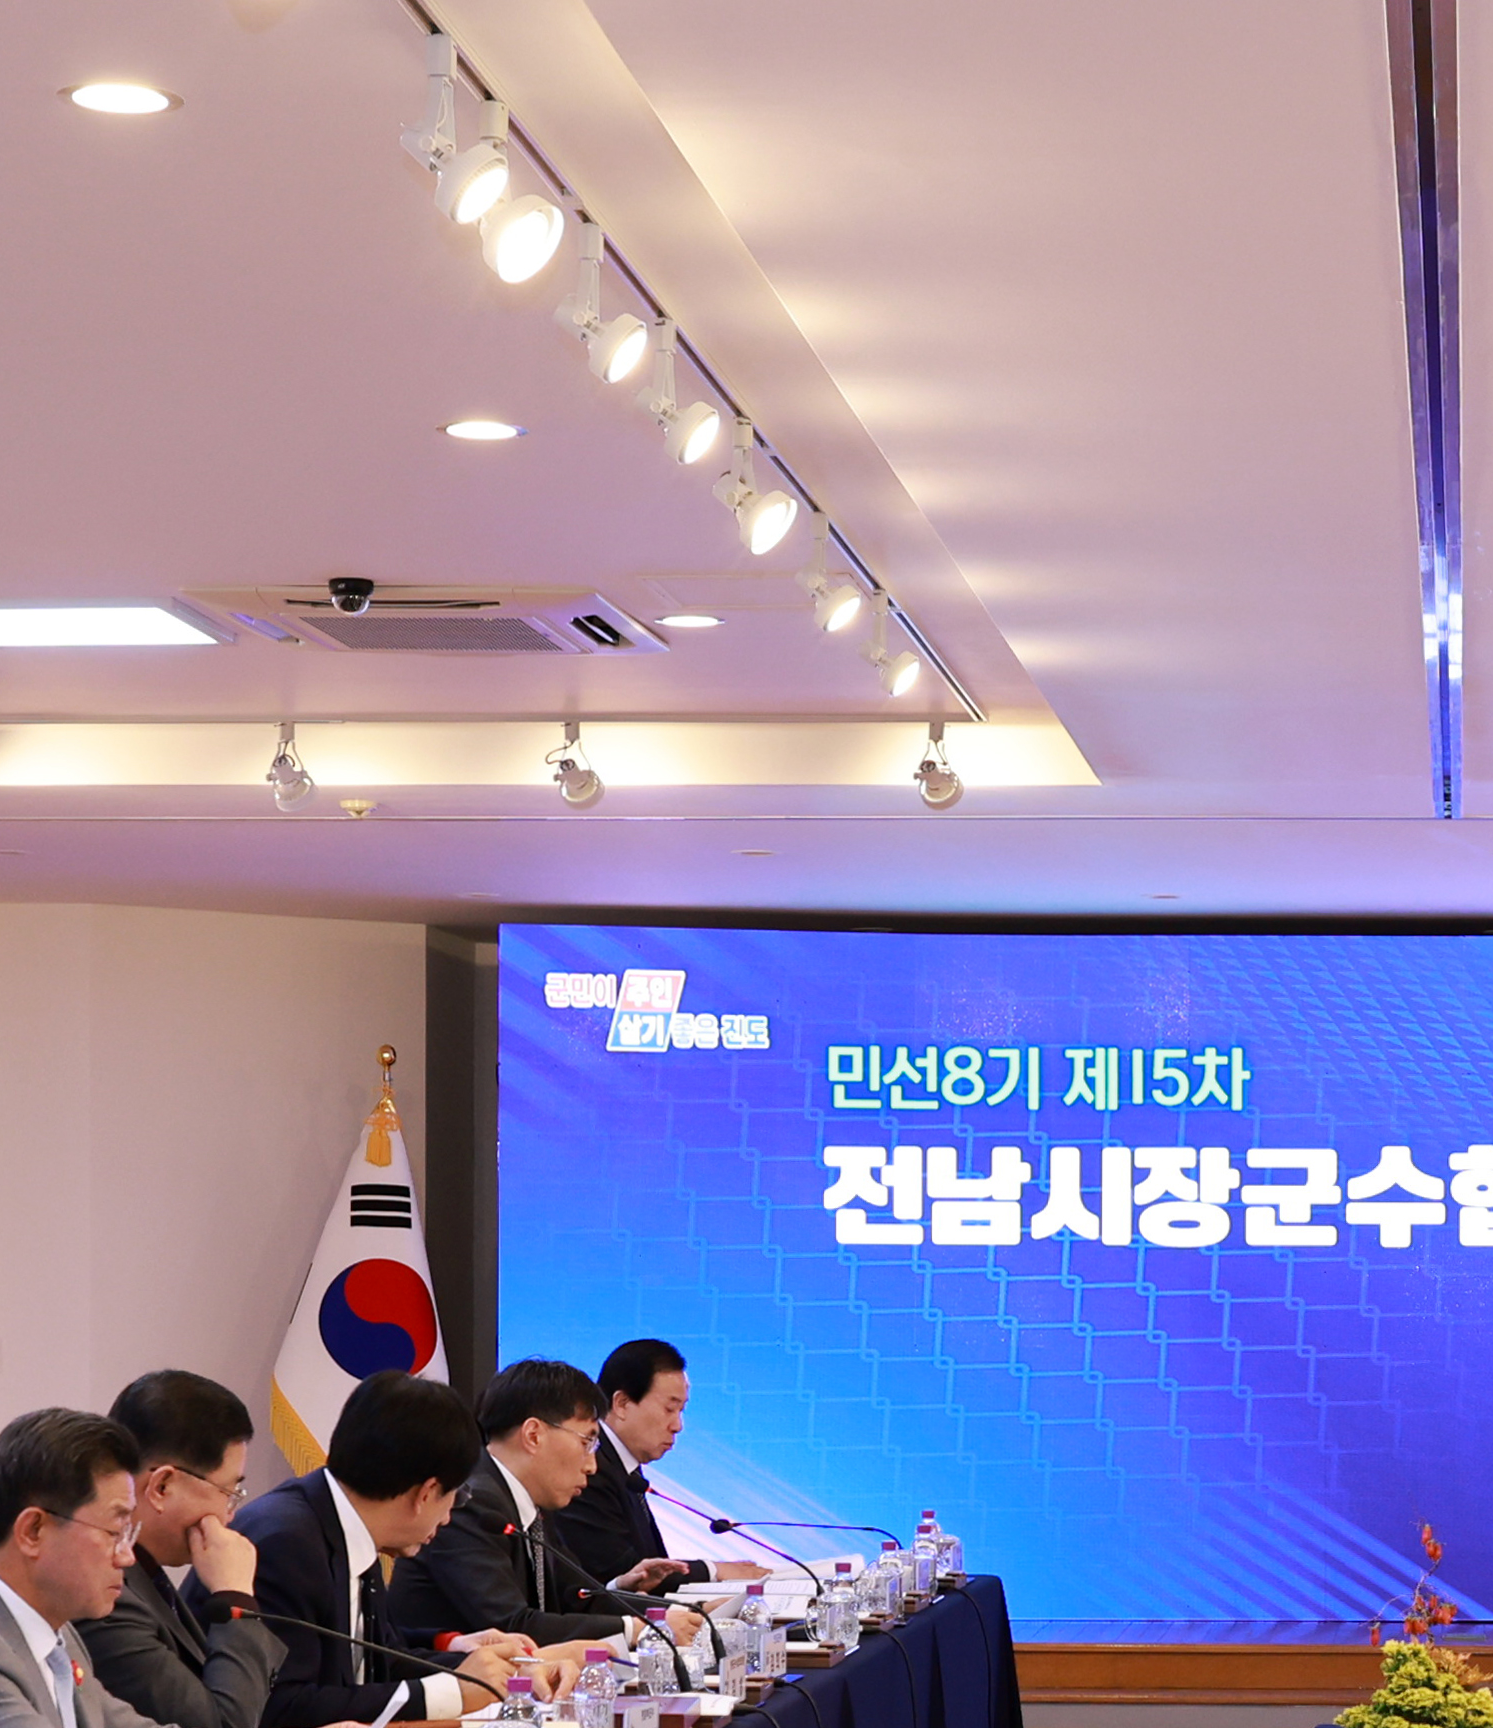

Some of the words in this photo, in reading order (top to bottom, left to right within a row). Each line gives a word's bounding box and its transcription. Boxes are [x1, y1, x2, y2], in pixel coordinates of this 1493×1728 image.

[544, 972, 617, 1009] 군민이
[625, 975, 674, 1008] 주인
[617, 1013, 665, 1047] 살기
[671, 1012, 719, 1049] 좋은
[720, 1014, 770, 1049] 진도
[829, 1046, 1038, 1109] 민선8기
[1064, 1048, 1250, 1110] 제15차
